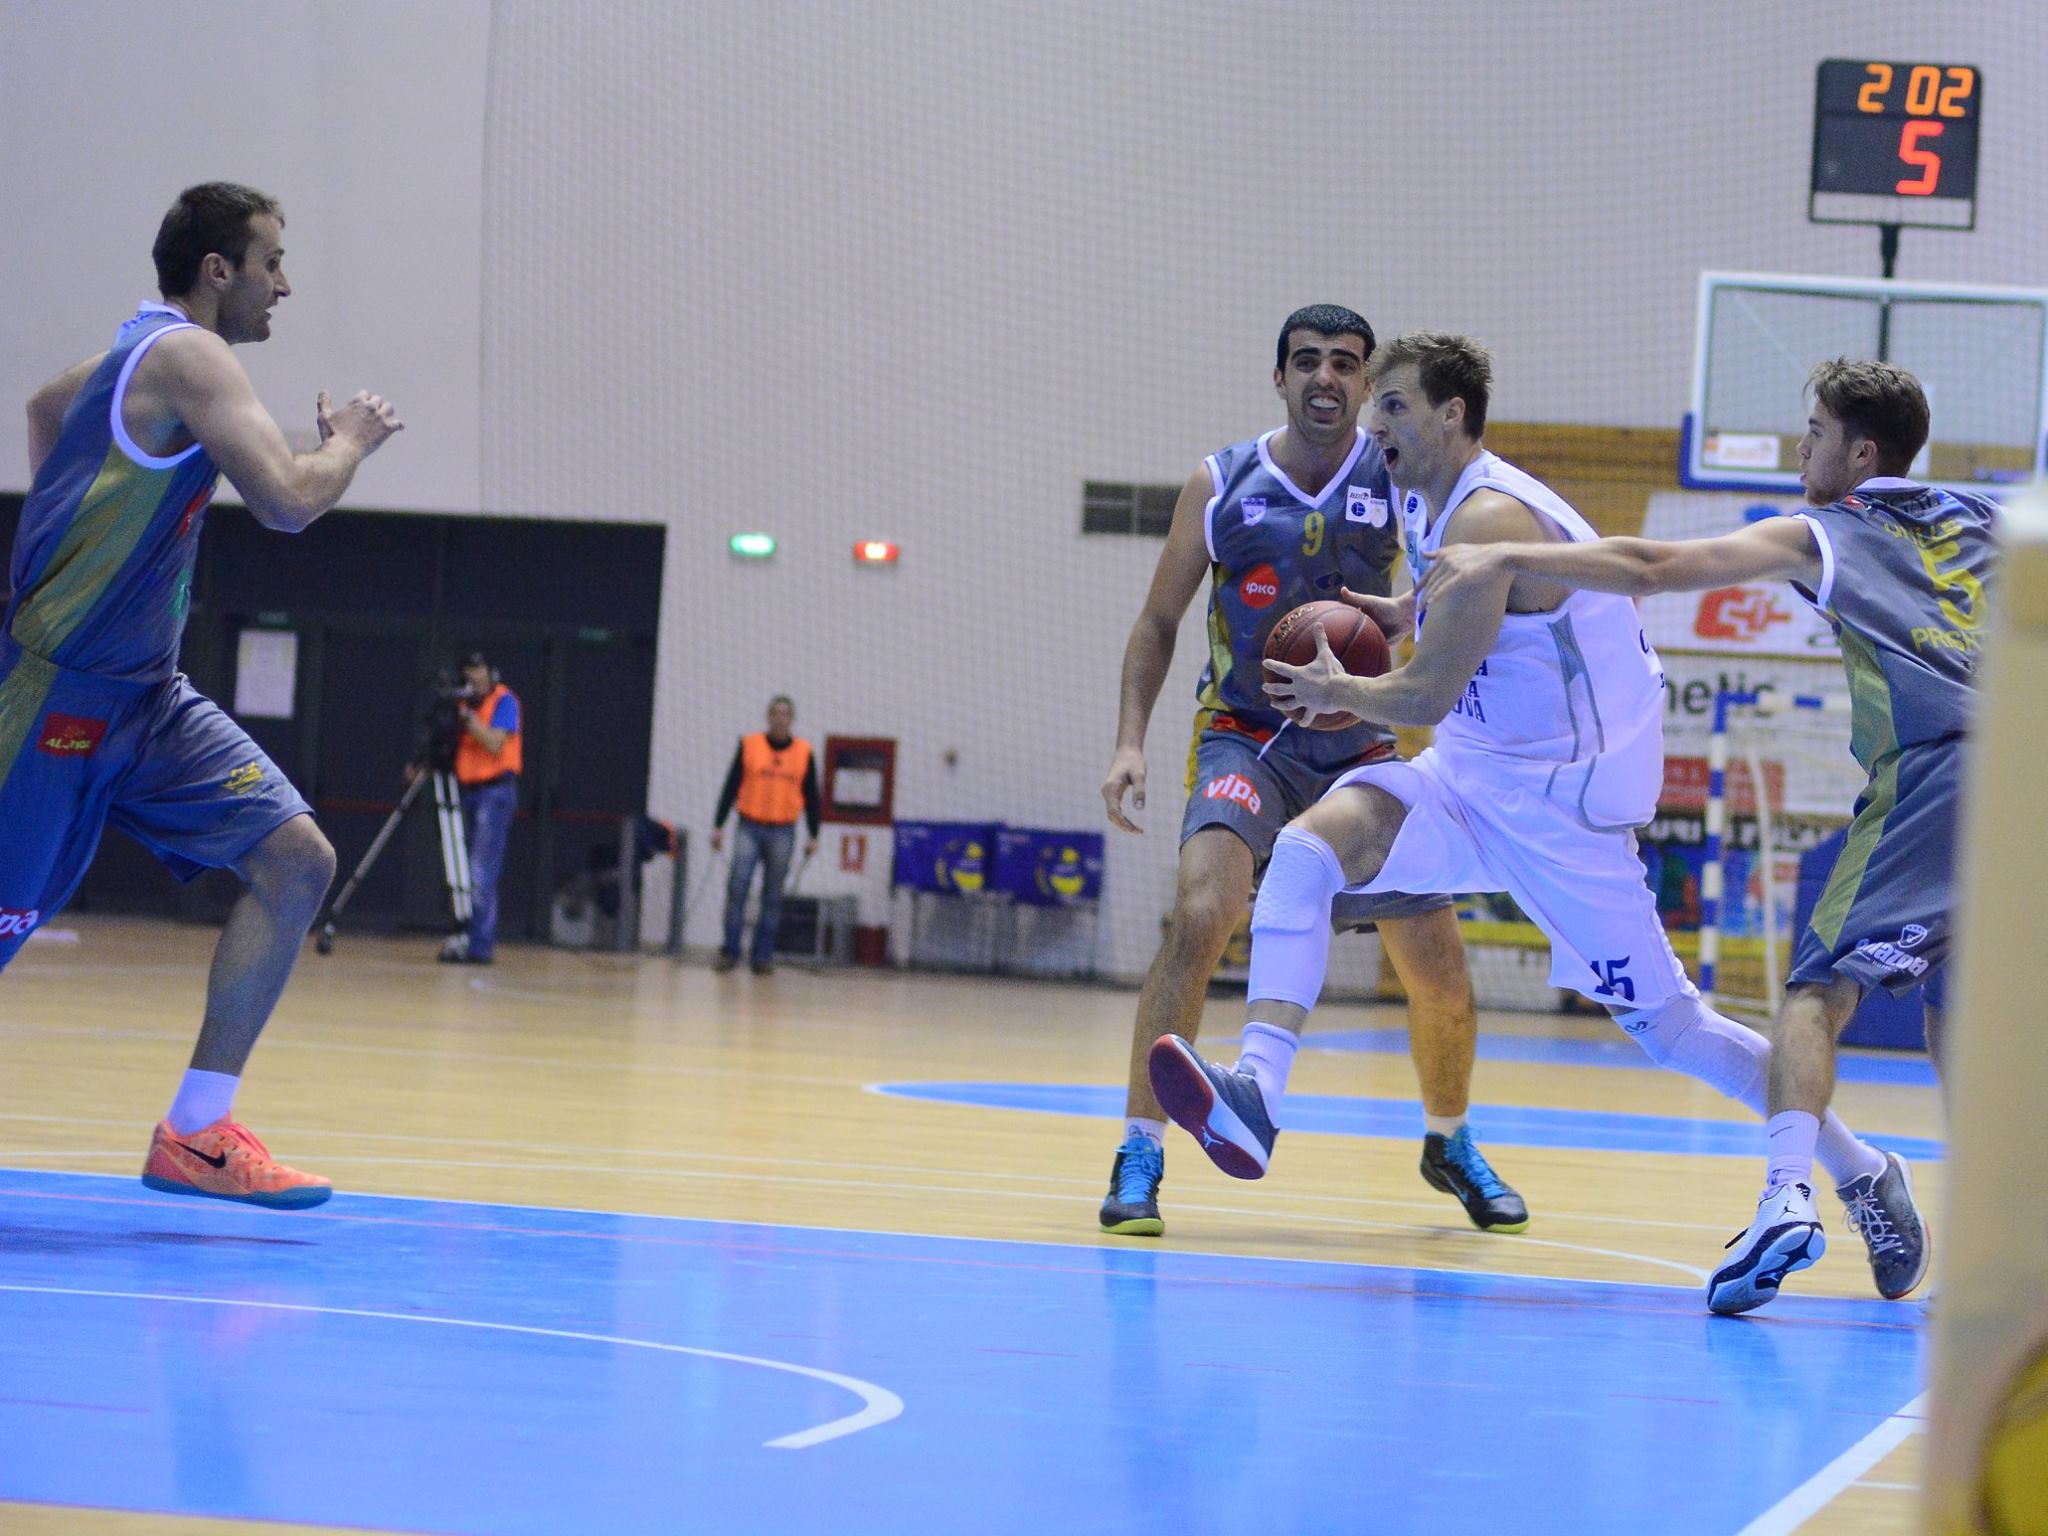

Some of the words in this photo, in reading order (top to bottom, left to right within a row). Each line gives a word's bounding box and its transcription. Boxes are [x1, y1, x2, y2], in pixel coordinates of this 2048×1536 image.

[1857, 63, 1894, 114] 2
[1905, 65, 1974, 118] 02
[1895, 120, 1945, 196] 5
[1302, 511, 1325, 557] 9
[1919, 540, 1989, 631] 5
[1207, 773, 1262, 815] vipa
[1590, 955, 1635, 1003] 15
